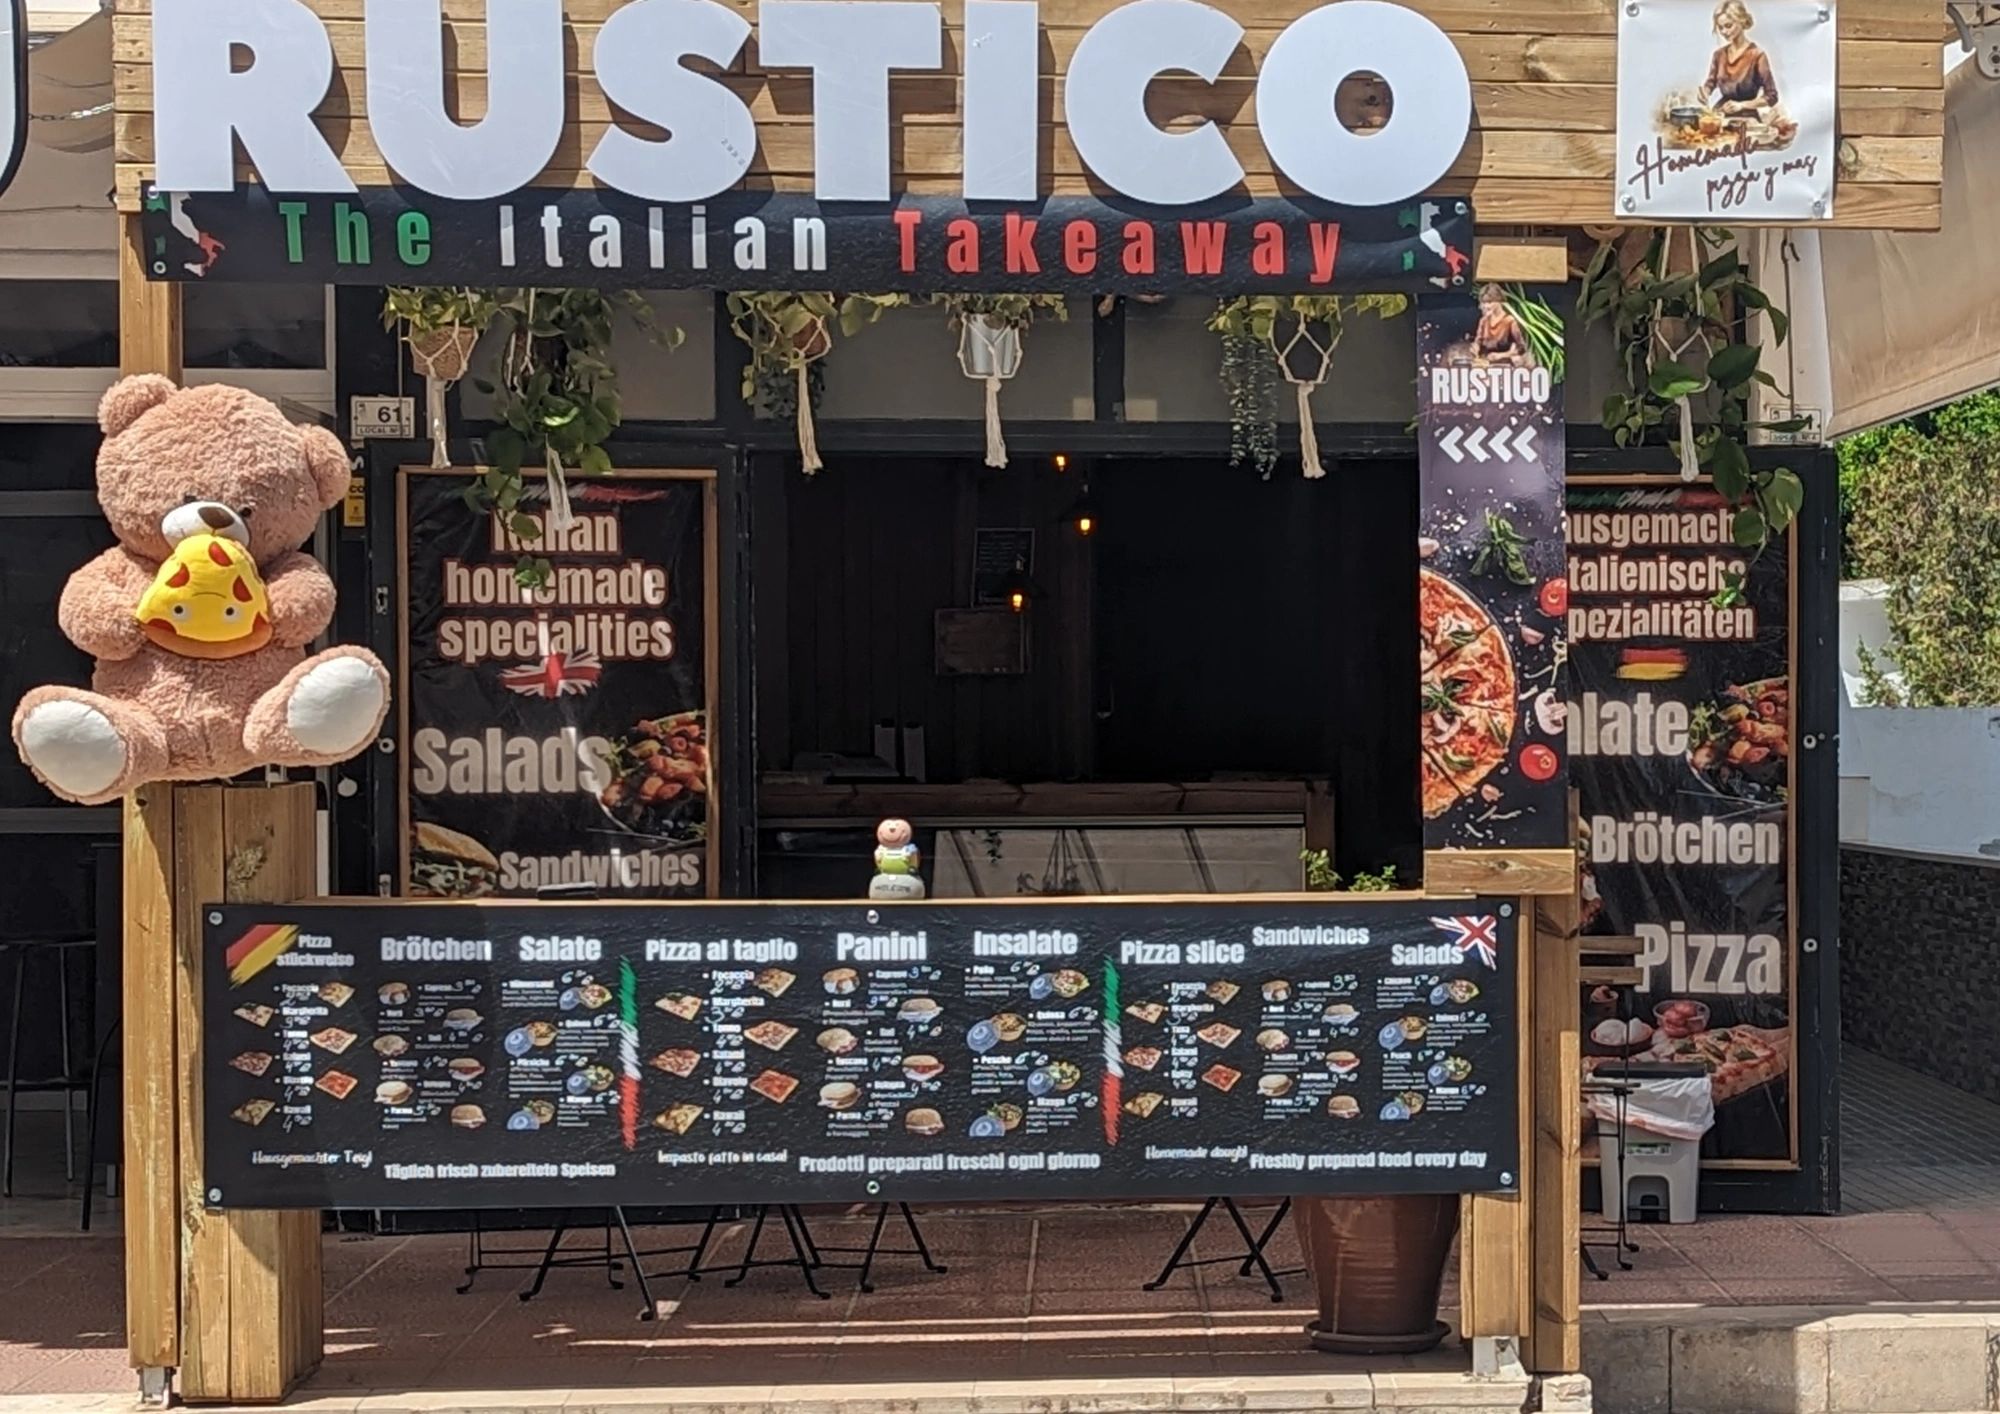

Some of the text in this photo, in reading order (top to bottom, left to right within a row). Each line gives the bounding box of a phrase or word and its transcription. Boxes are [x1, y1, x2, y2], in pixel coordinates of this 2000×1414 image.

[154, 0, 1472, 206] RUSTICO
[1628, 122, 1768, 200] Homemade
[279, 202, 1341, 284] The Italian Takeaway
[1432, 366, 1550, 404] RUSTICO
[377, 406, 401, 423] 61
[446, 561, 666, 605] homemade
[440, 613, 673, 664] specialities
[412, 726, 612, 794] Salads
[1592, 811, 1780, 865] Brötchen
[500, 848, 700, 889] Sandwiches
[298, 934, 332, 948] Pizza
[381, 936, 492, 961] Brötchen
[519, 936, 602, 961] Salate
[836, 931, 927, 961] Panini
[974, 930, 1079, 956] Insalate
[1252, 926, 1370, 946] Sandwiches
[645, 938, 798, 963] Pizza al taglio
[1121, 940, 1245, 965] Pizza slice
[1391, 944, 1464, 966] Salads
[1634, 920, 1782, 995] Pizza
[384, 1163, 434, 1180] Täglich
[561, 1163, 616, 1180] Speisen
[799, 1152, 1101, 1174] Prodotti preparati freschi ogni giorno
[1250, 1151, 1487, 1170] Freshly prepared food every day
